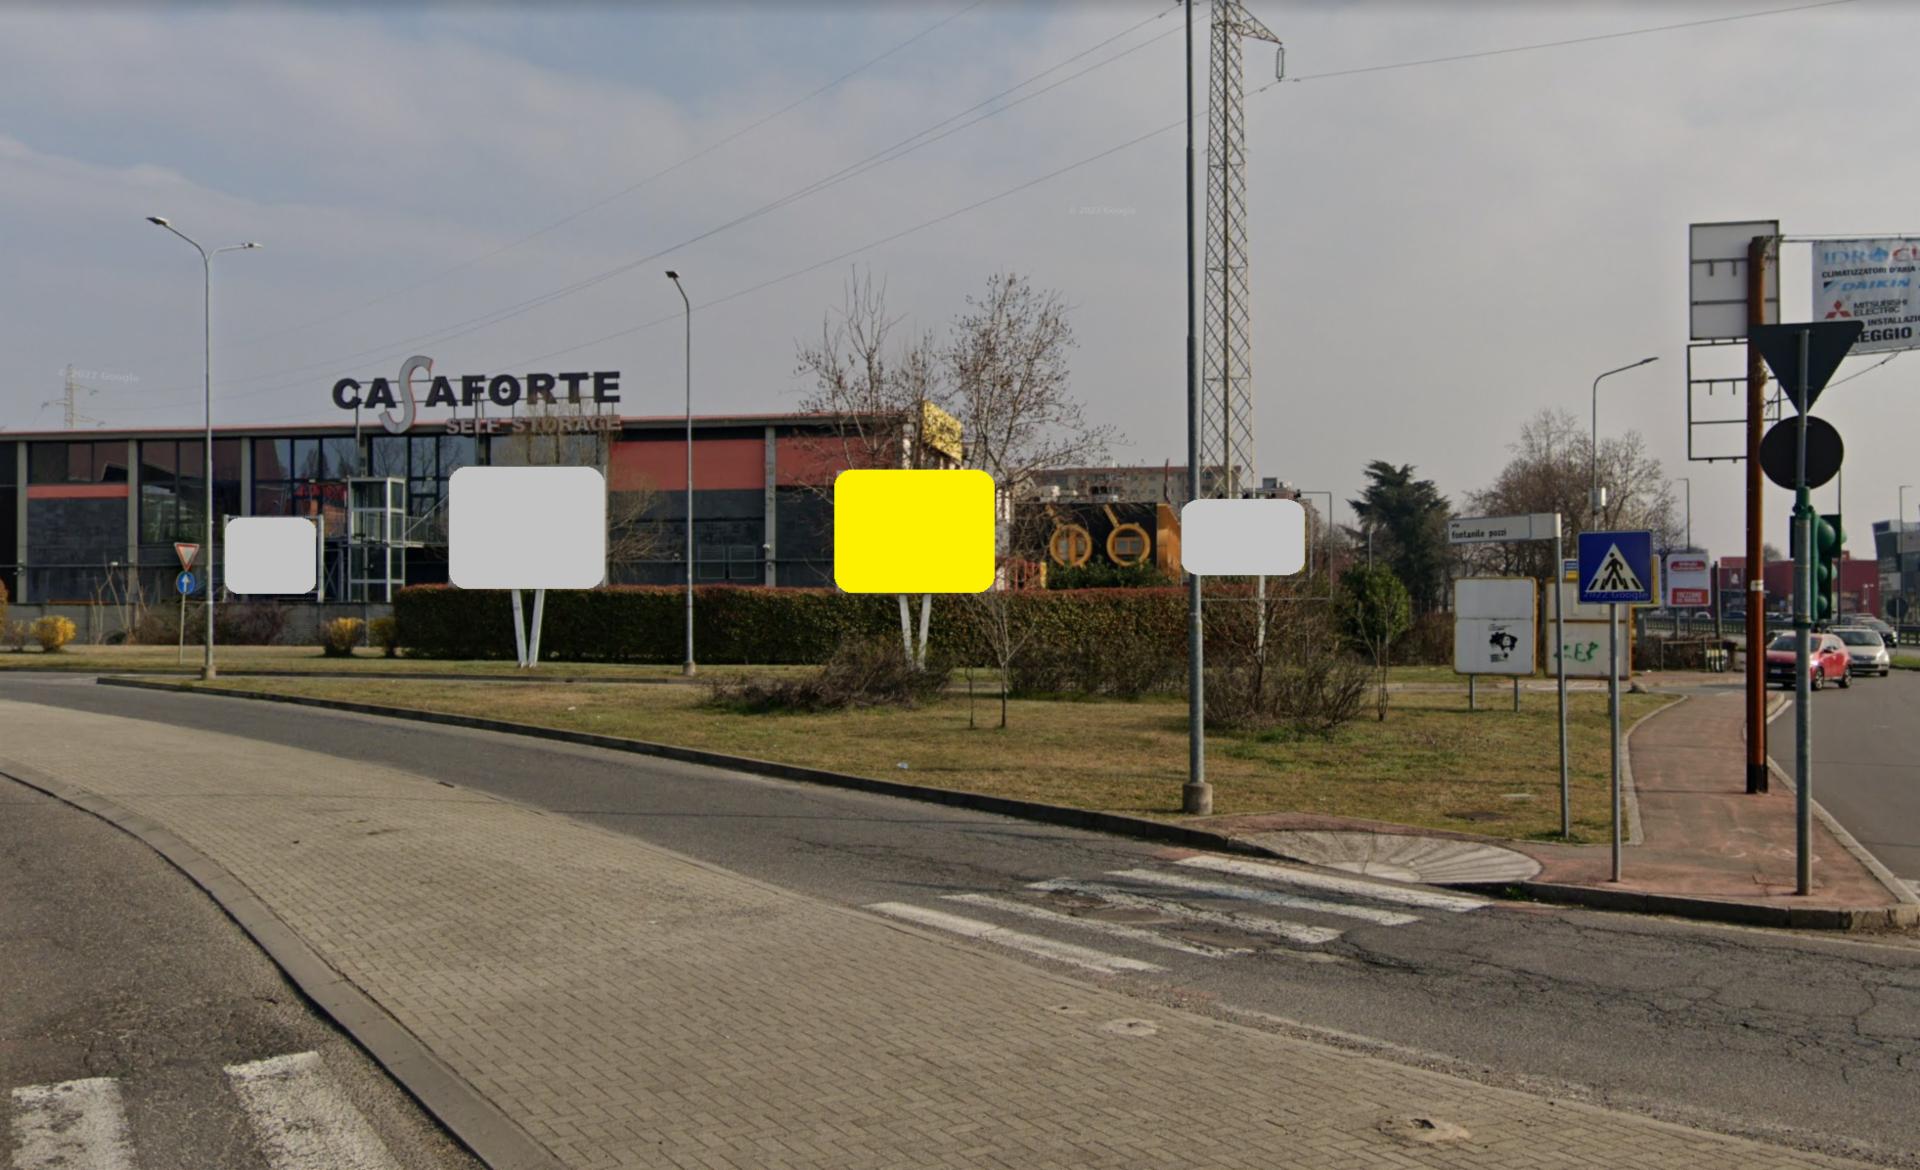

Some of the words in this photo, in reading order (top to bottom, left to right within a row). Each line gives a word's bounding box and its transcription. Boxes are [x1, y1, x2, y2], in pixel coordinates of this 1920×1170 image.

[1822, 267, 1886, 278] CLIMATIZZATORI
[1889, 265, 1916, 274] D'ARIA
[1841, 277, 1911, 291] DAIKIN
[1853, 299, 1908, 309] MITSUBISHI
[1853, 306, 1900, 317] ELECTRIC
[332, 355, 621, 434] CASAFORTE
[445, 417, 501, 435] SELF
[511, 414, 622, 433] STORAGE
[1452, 529, 1485, 539] fontanile
[1488, 528, 1507, 539] pozzi
